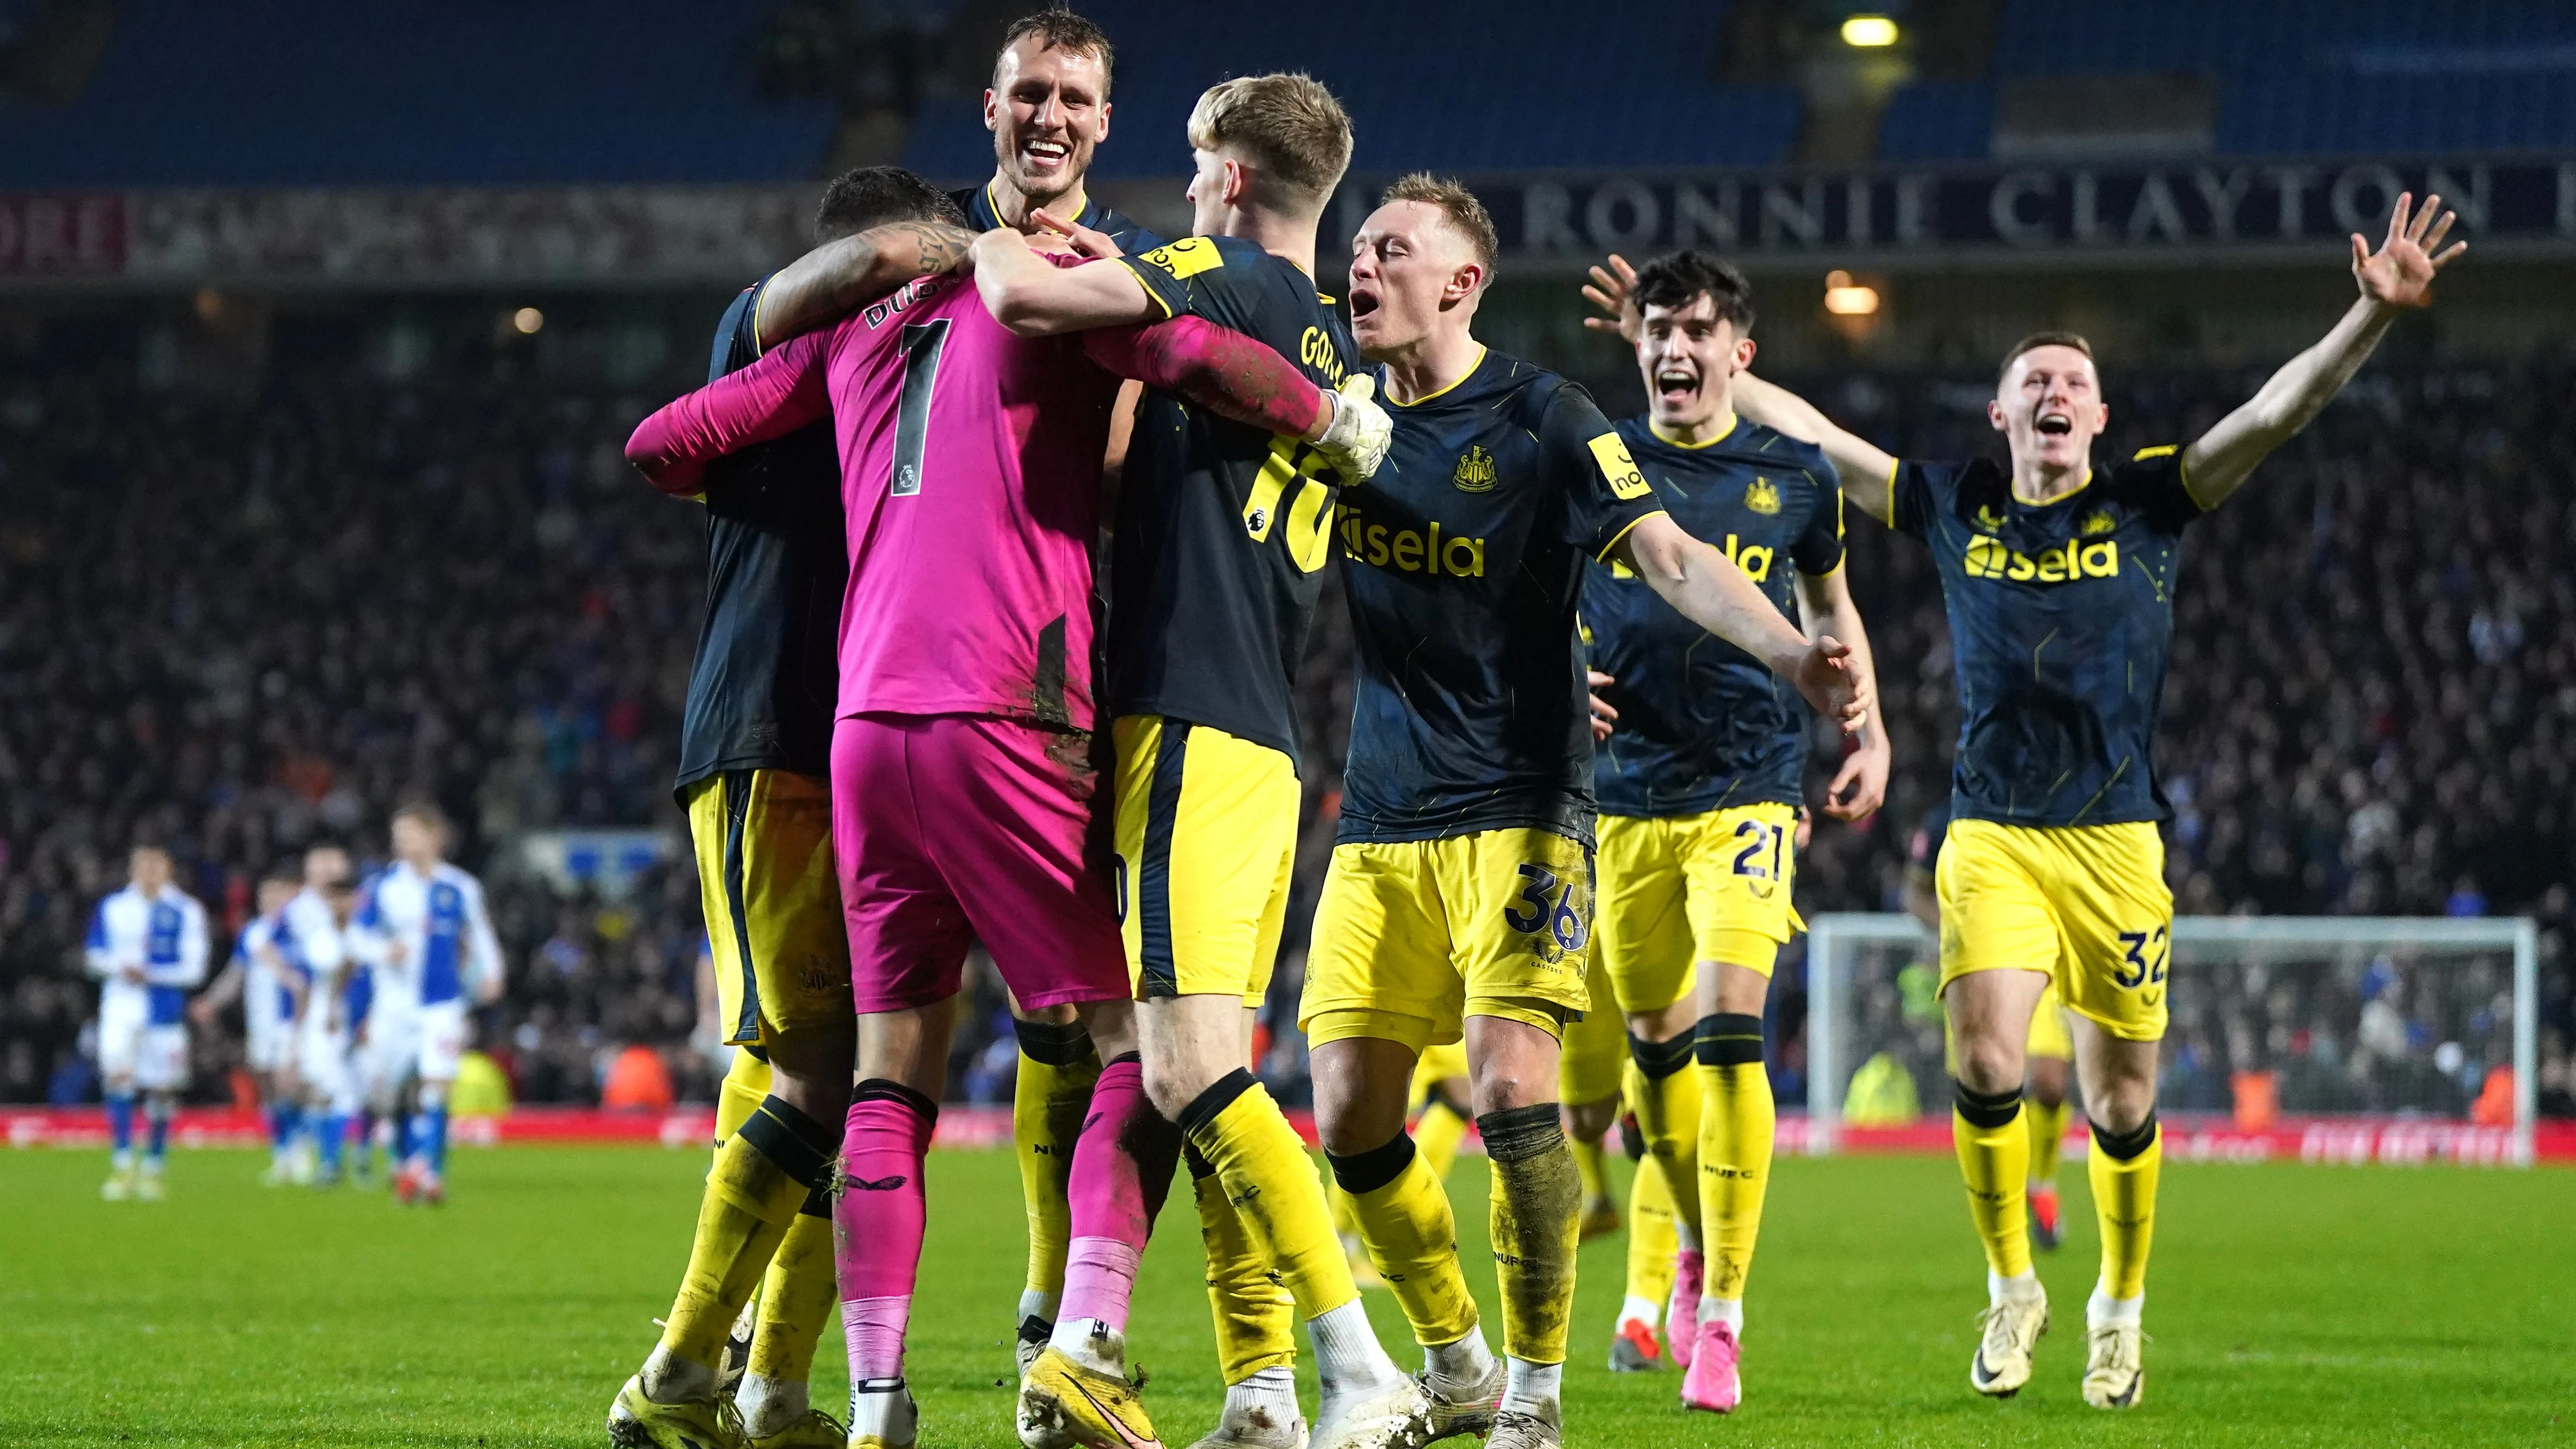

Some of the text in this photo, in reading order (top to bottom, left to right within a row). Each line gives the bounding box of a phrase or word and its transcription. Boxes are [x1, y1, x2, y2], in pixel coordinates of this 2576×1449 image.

[1522, 175, 1937, 257] RONNIE
[1988, 163, 2493, 245] CLAYTON
[891, 318, 952, 496] 1
[1242, 432, 1335, 573] 10
[1367, 521, 1484, 577] sela
[1706, 534, 1774, 583] la
[2007, 537, 2119, 582] sela
[1733, 819, 1784, 882] 21
[1504, 862, 1587, 952] 36
[1531, 961, 1563, 974] CASTORE
[2114, 924, 2166, 988] 32
